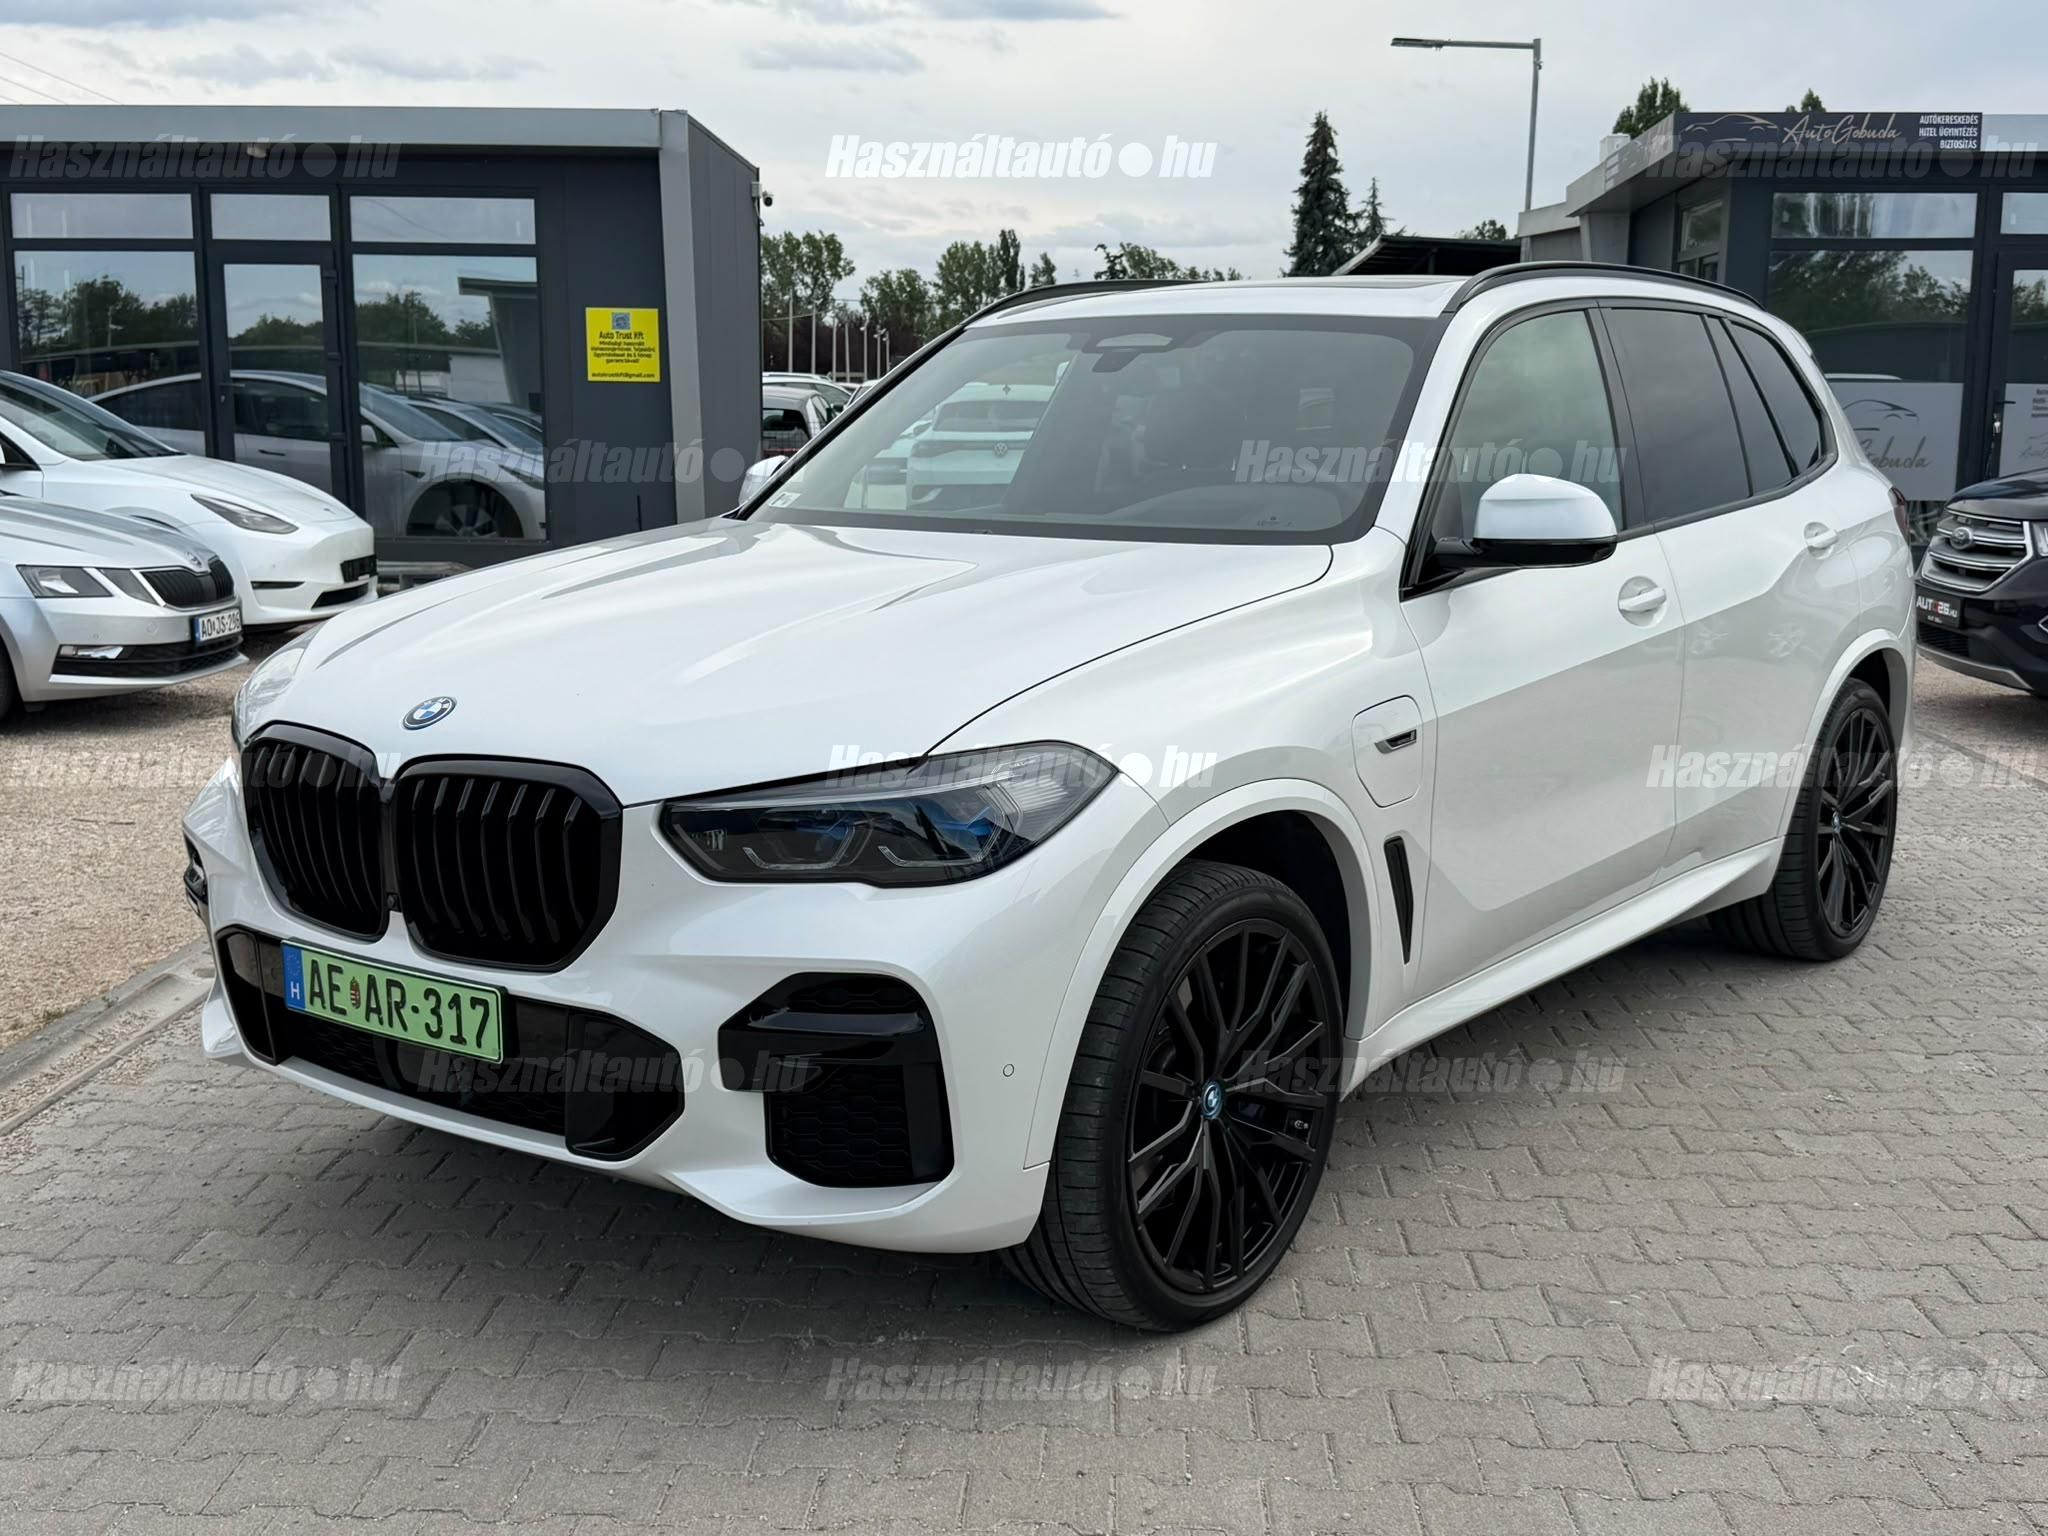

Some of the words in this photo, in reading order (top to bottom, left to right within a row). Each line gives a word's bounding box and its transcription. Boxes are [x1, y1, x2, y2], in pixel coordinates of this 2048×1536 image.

[1919, 114, 1978, 124] AUTÓKERESKEDÉS
[1919, 127, 1938, 137] HITEL
[1939, 126, 1978, 137] ÜGYINTÉZÉS
[1939, 138, 1977, 149] BIZTOSÍTÁS
[599, 331, 614, 340] Auto
[616, 331, 632, 340] Trust
[290, 980, 300, 1000] H
[309, 958, 348, 1016] AE
